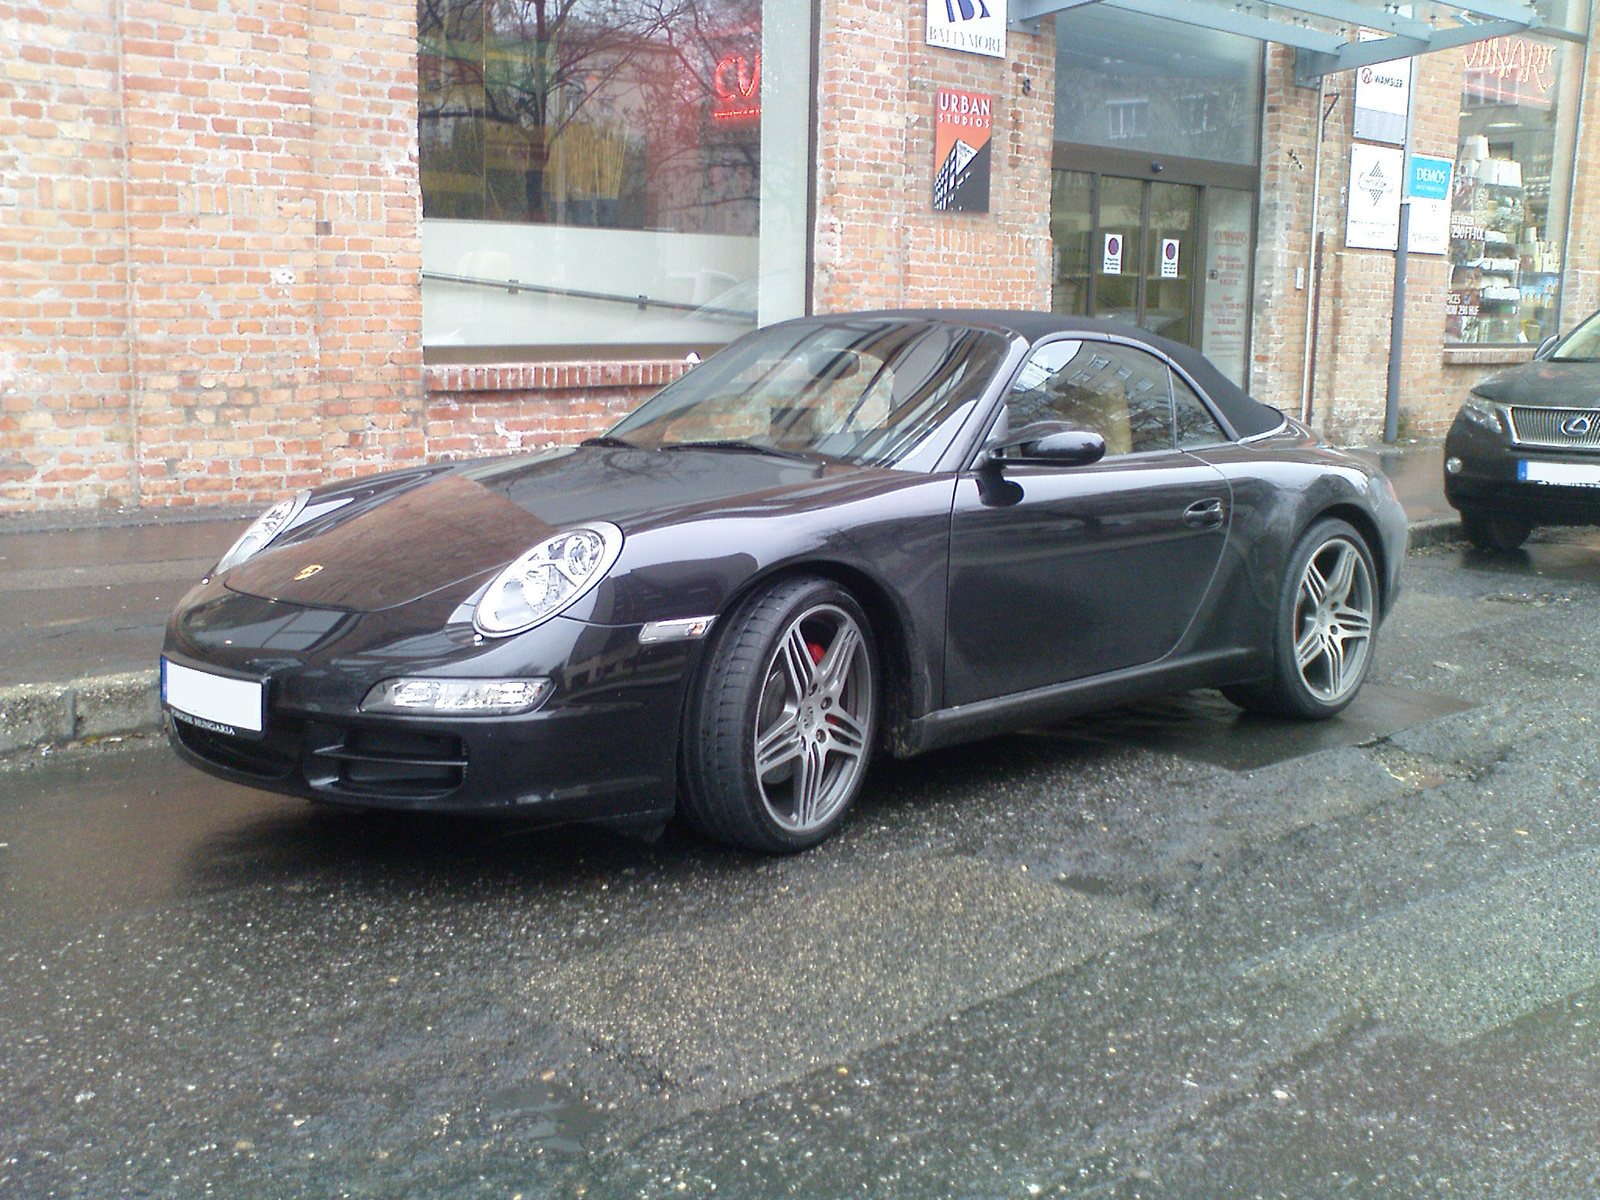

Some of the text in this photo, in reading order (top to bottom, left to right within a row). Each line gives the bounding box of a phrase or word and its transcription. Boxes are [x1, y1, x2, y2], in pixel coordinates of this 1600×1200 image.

[1022, 78, 1031, 96] 8
[940, 92, 991, 116] URBAN
[939, 112, 990, 128] STUDIOS
[1416, 167, 1446, 184] DEMOS
[194, 717, 236, 736] HUNGARIA
